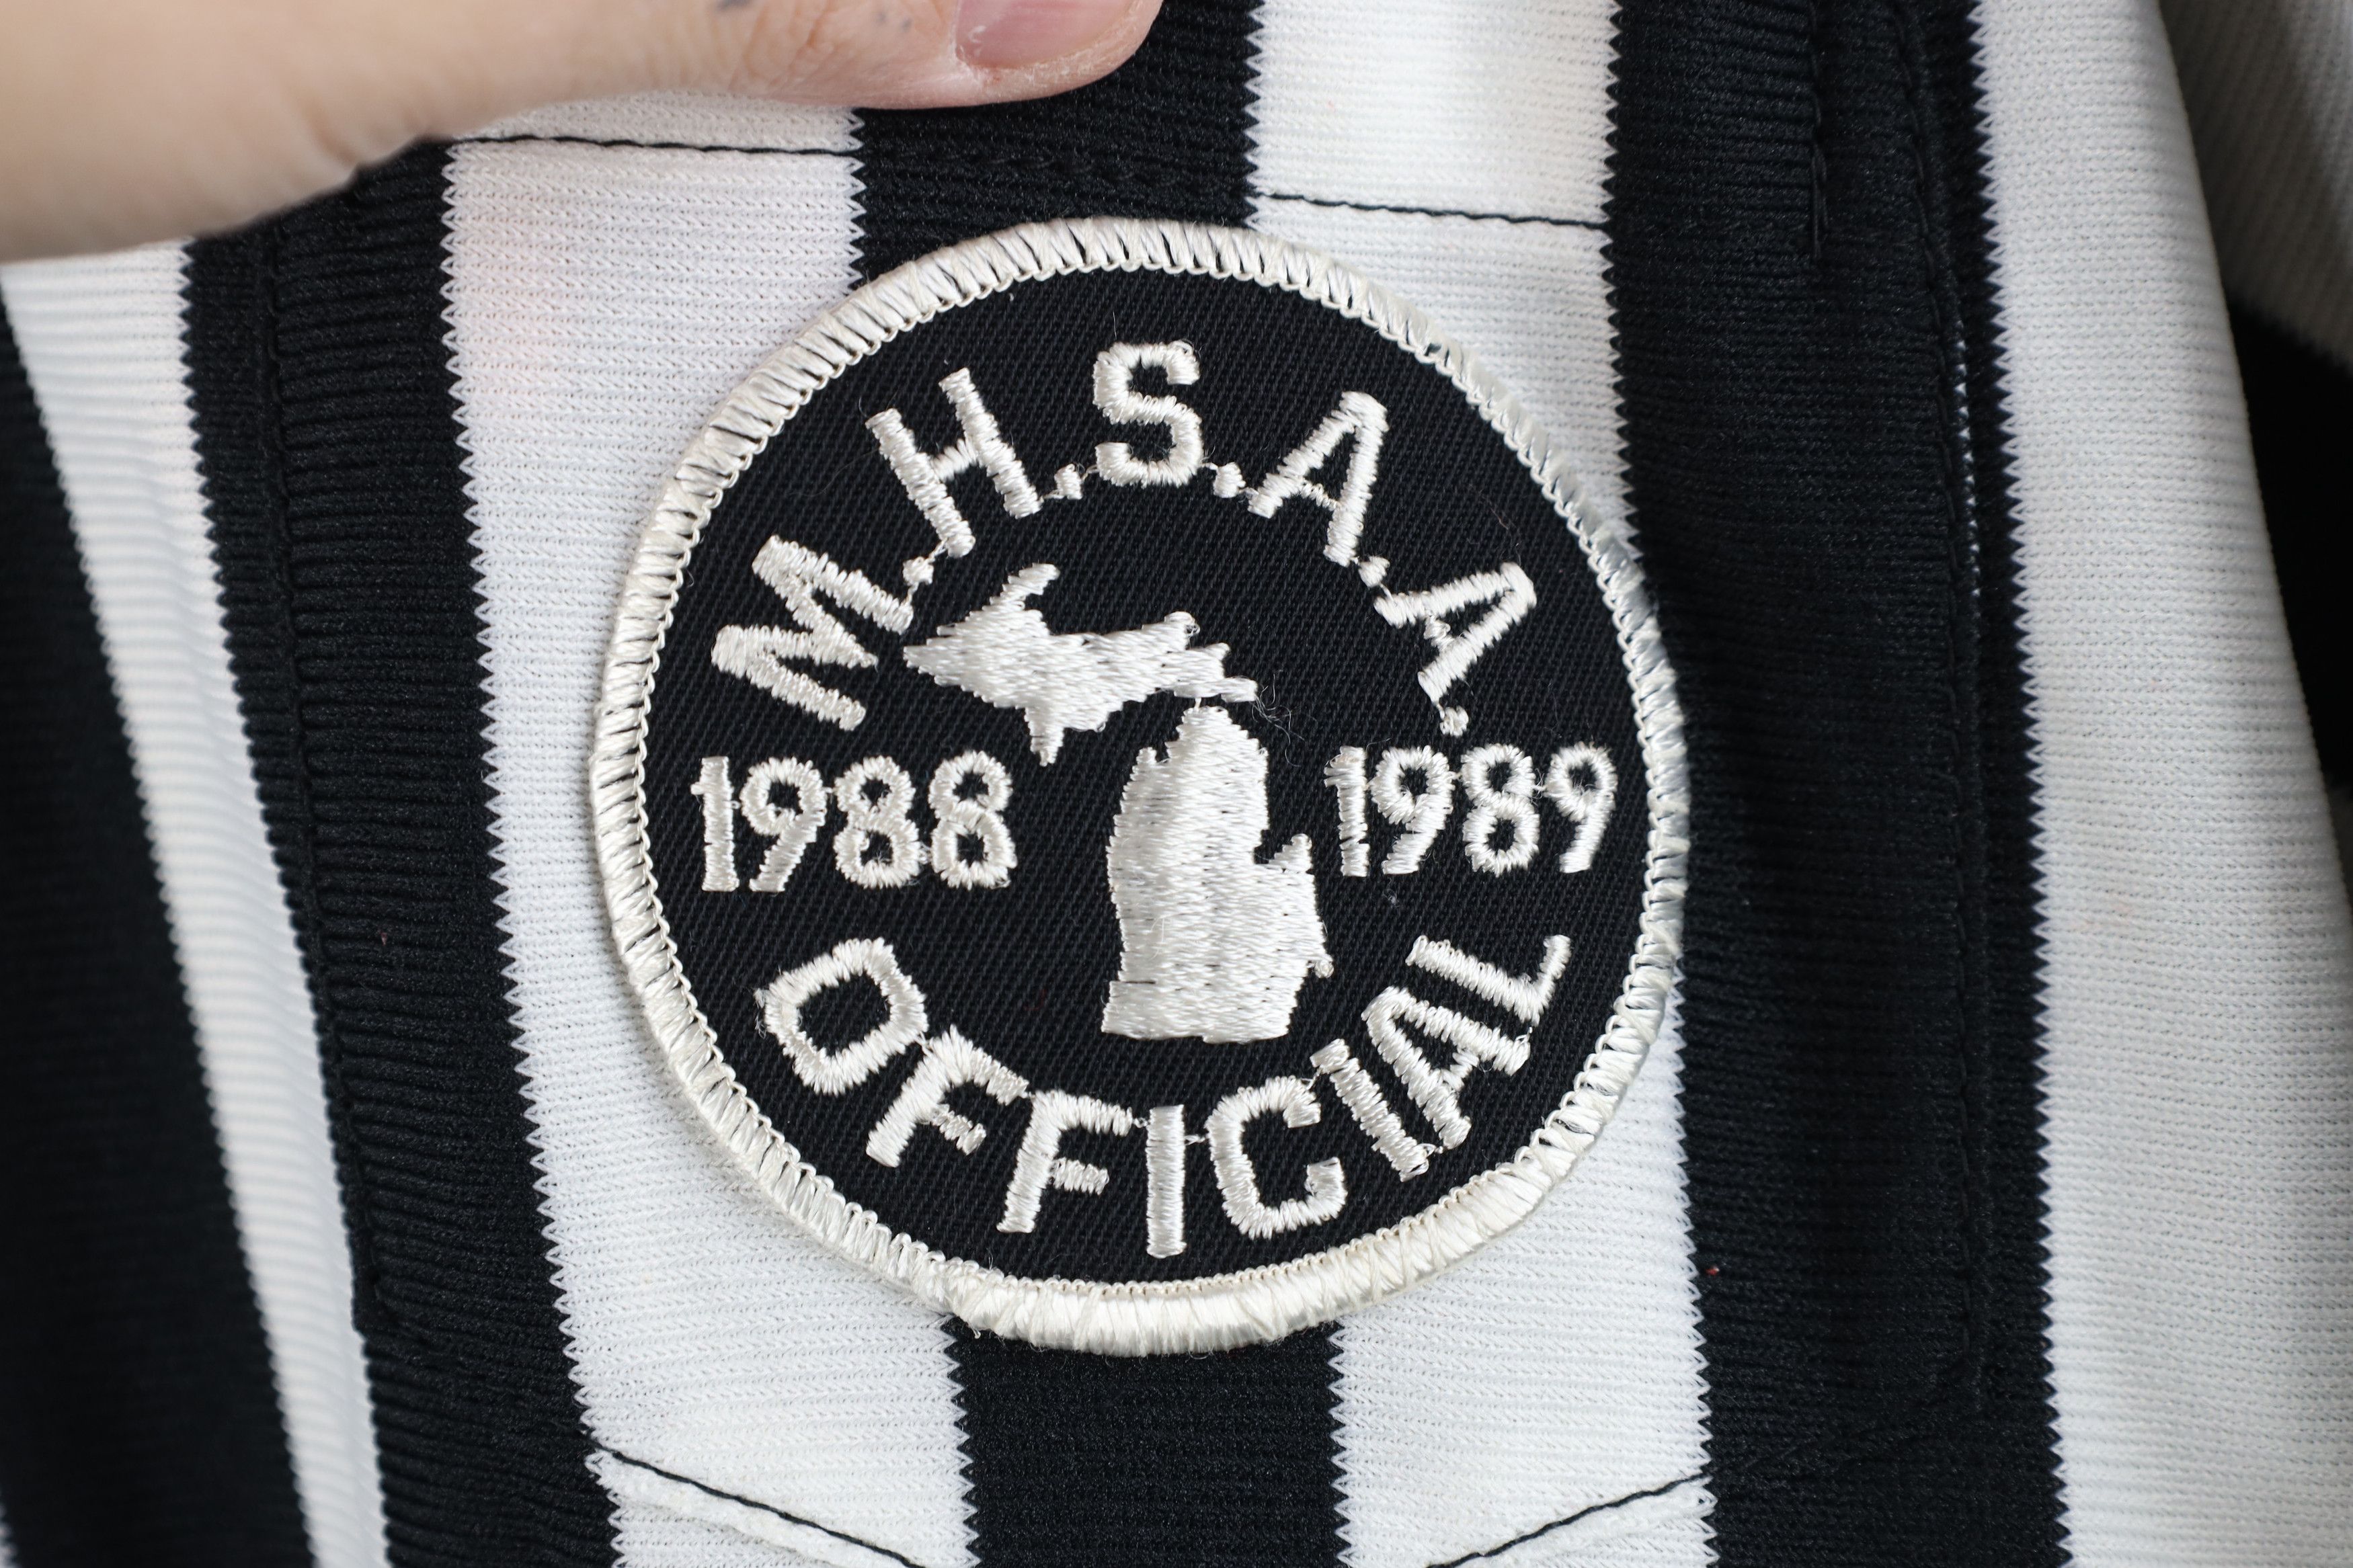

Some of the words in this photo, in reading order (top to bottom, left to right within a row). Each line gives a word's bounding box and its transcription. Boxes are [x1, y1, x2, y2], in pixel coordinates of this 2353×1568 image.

[690, 750, 1017, 892] 1988
[1324, 742, 1618, 877] 1989
[754, 935, 1571, 1257] OFFICIAL
